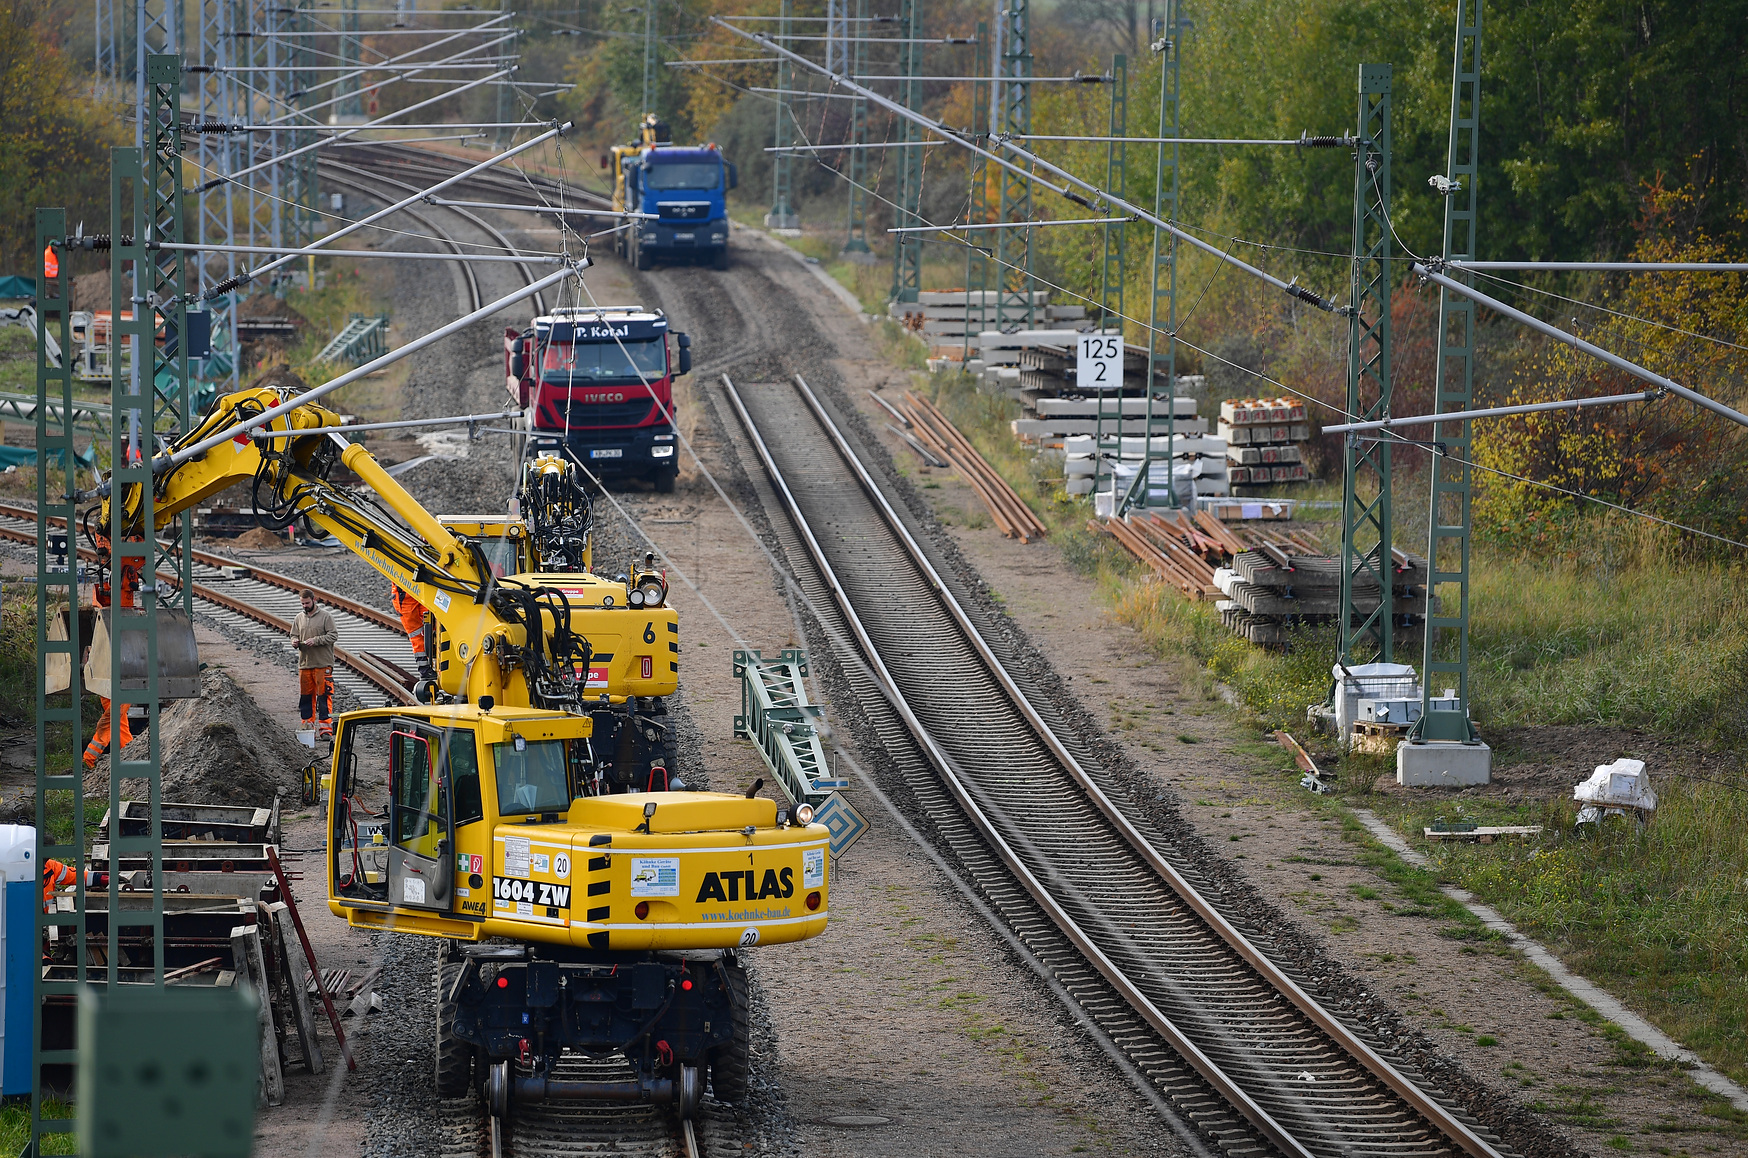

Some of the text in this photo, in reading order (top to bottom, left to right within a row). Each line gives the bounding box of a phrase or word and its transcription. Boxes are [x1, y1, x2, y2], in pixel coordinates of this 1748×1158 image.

[591, 325, 629, 338] Kotal
[1083, 339, 1118, 359] 125
[1094, 361, 1107, 382] 2
[585, 393, 624, 403] IVECO
[354, 539, 421, 597] www.koehnke-bau.de
[642, 621, 656, 645] 6
[556, 857, 568, 874] 20
[747, 852, 754, 866] 1
[492, 877, 570, 907] 1604 ZW
[695, 867, 794, 903] ATLAS
[701, 906, 791, 921] www.koehnke-bau.de
[740, 932, 757, 946] 20
